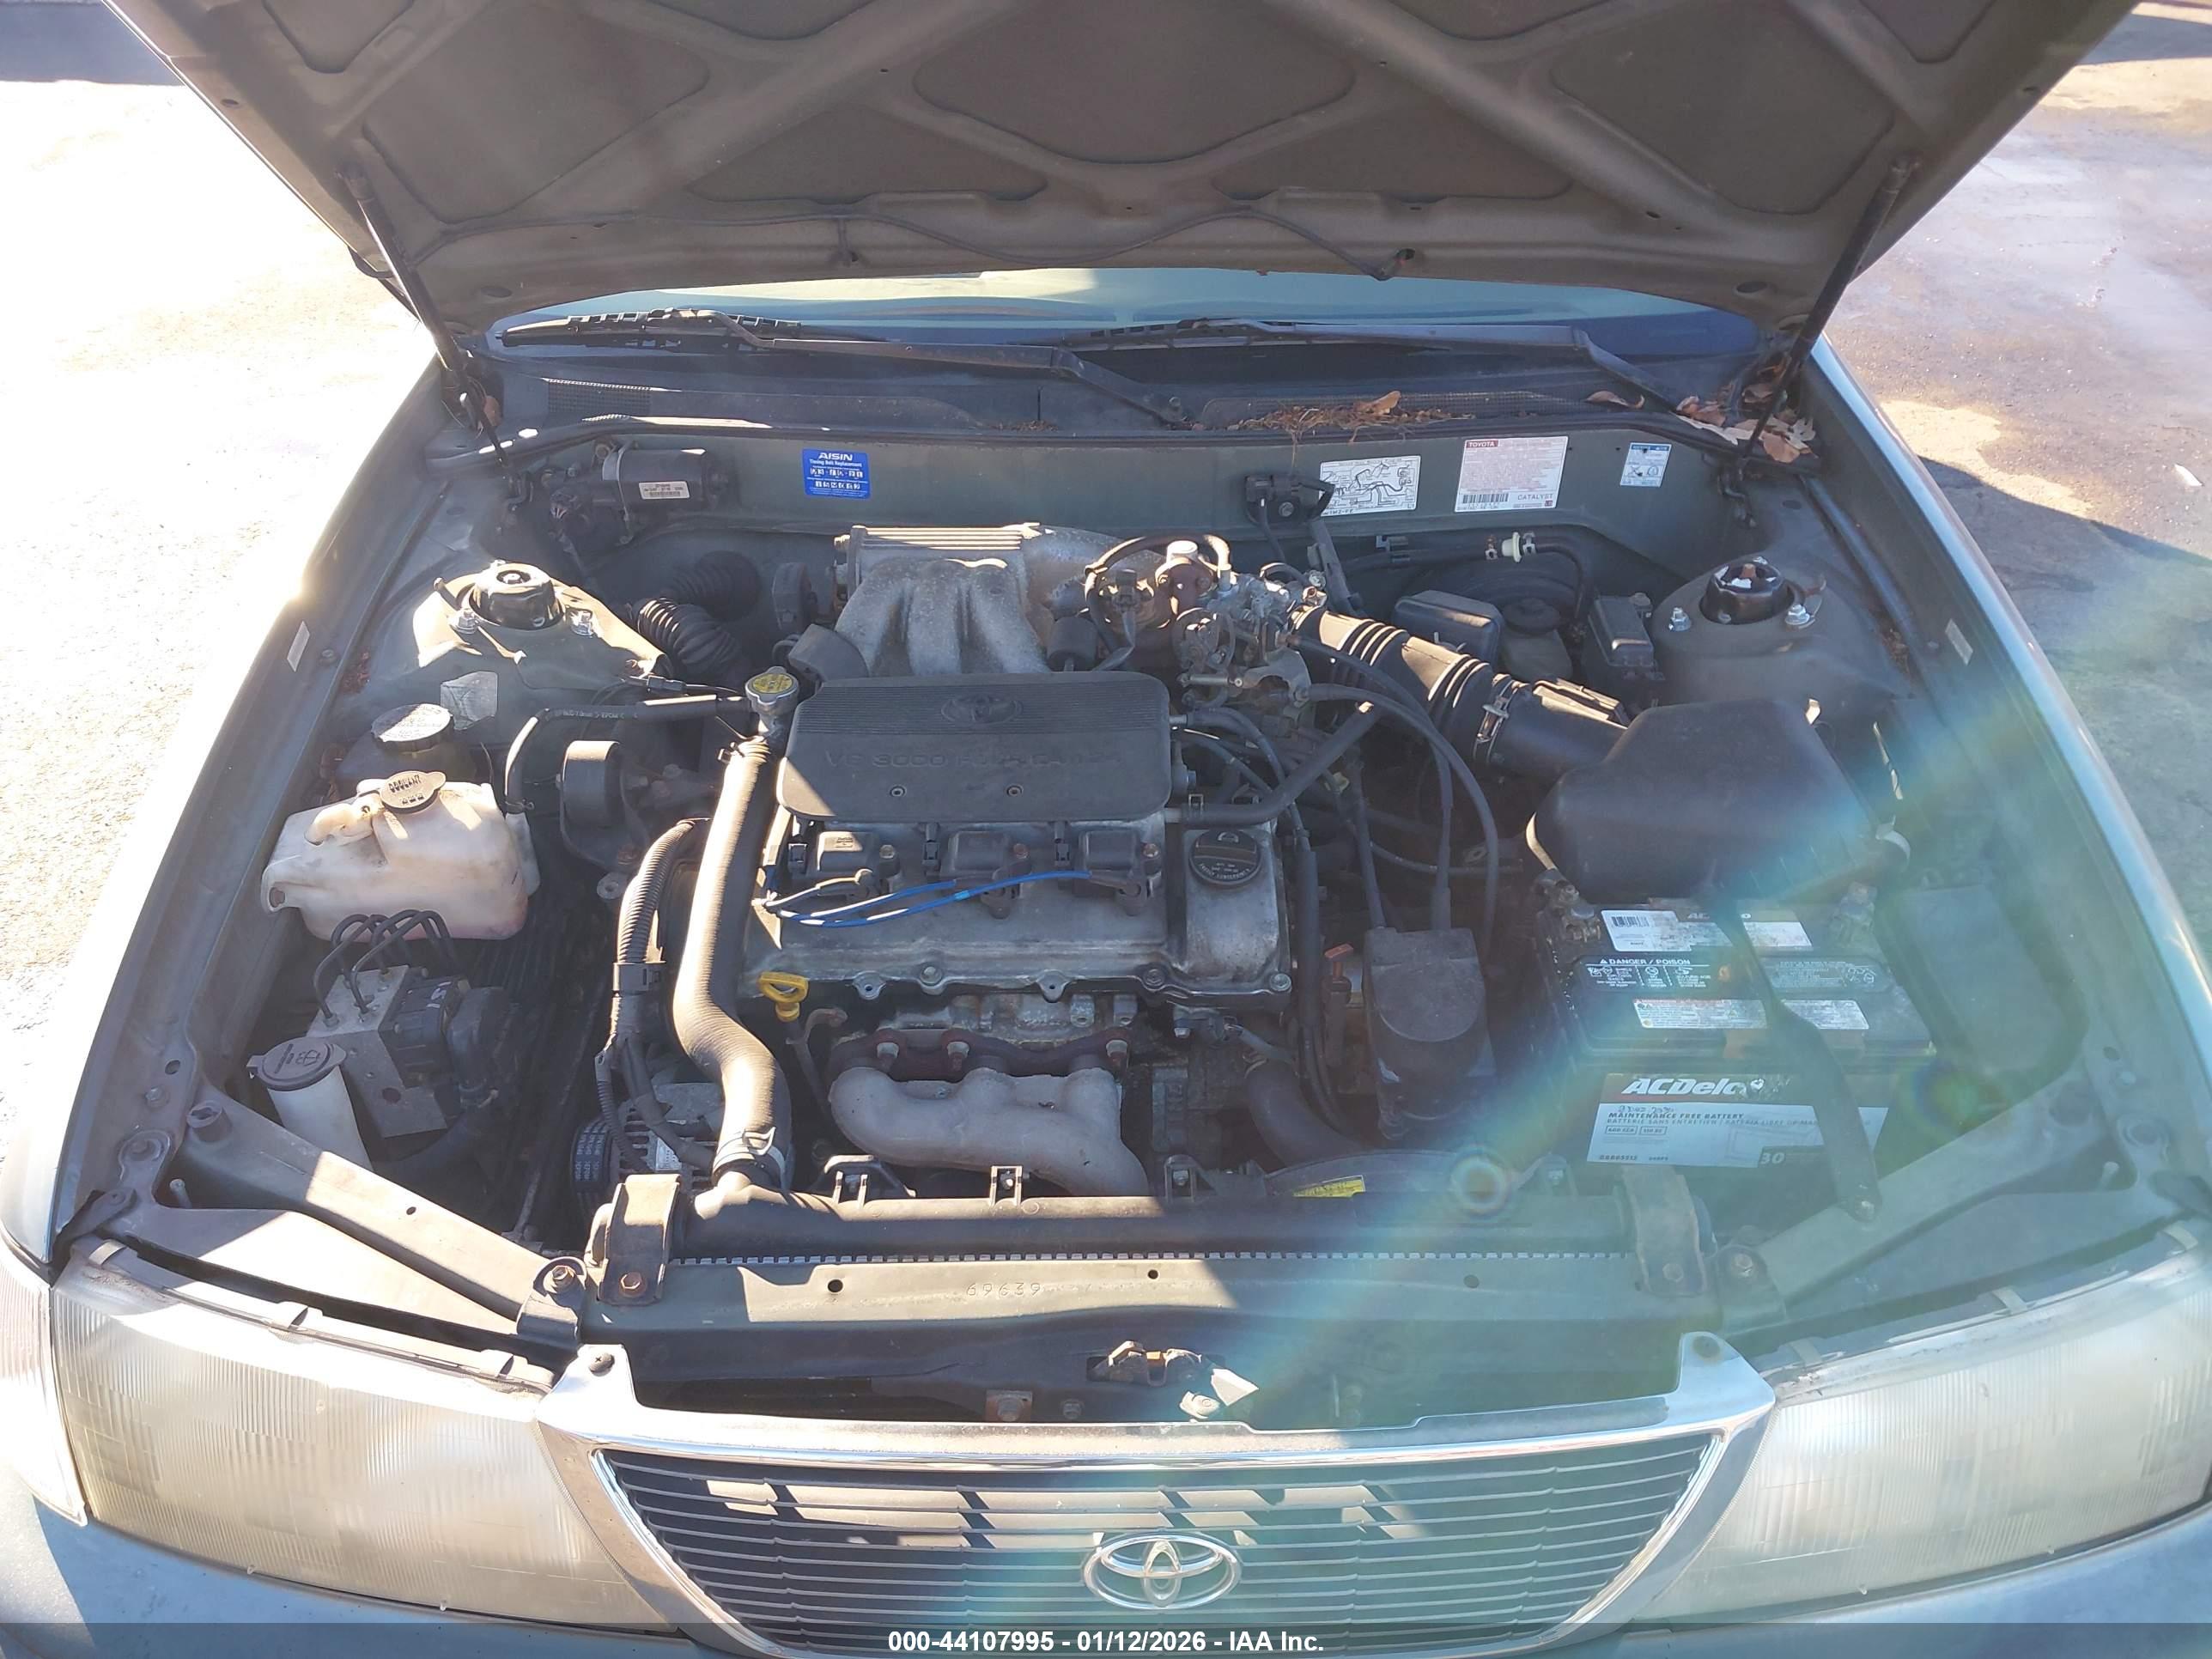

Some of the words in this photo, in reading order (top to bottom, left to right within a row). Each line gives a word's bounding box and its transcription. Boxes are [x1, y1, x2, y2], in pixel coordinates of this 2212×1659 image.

[818, 453, 853, 461] AISIN
[872, 753, 946, 768] 3000
[388, 774, 422, 793] COOLANT
[966, 1282, 1041, 1297] 69639
